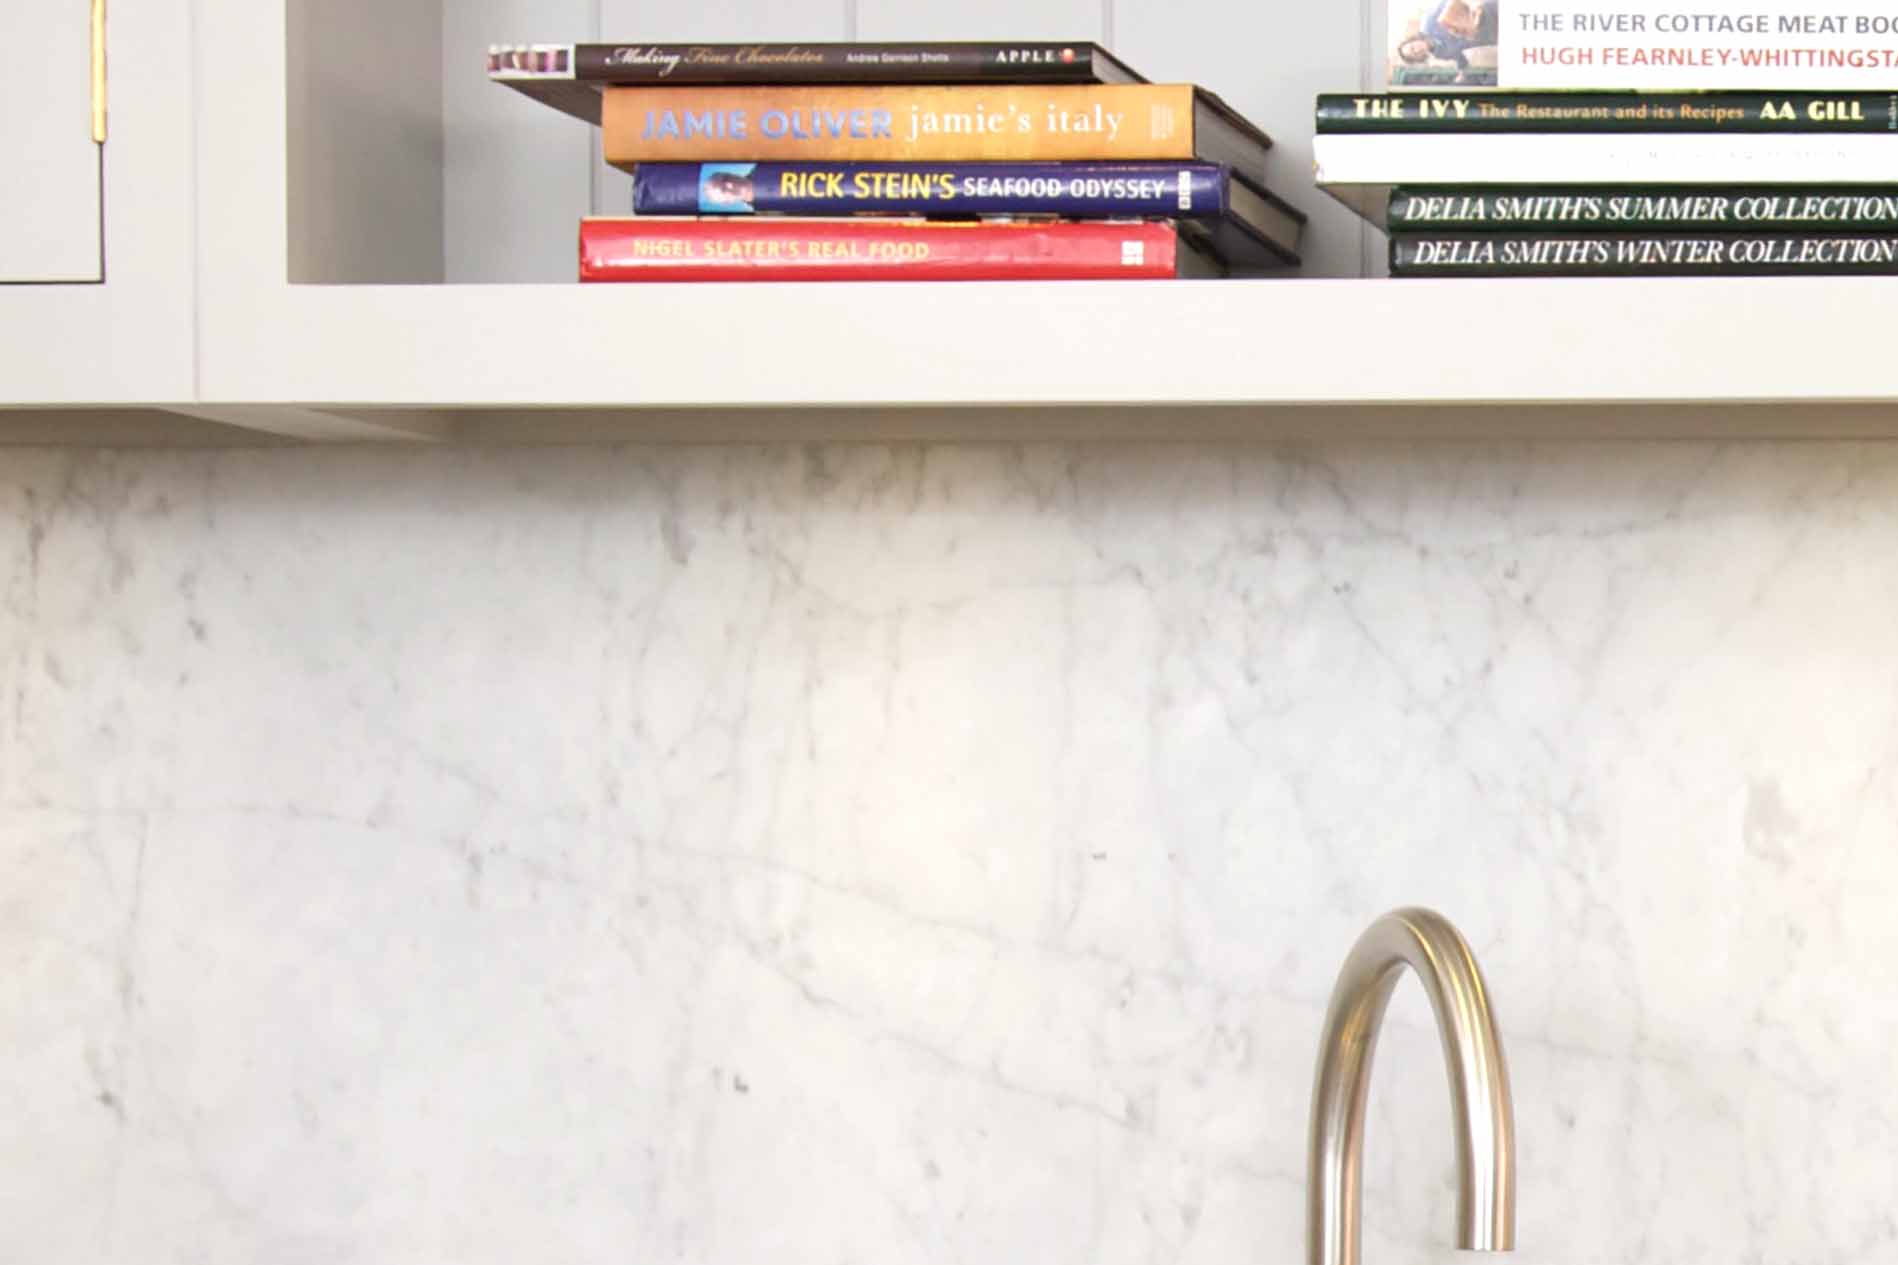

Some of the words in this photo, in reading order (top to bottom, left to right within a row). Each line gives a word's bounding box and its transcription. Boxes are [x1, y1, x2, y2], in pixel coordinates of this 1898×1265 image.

[1519, 13, 1563, 32] THE
[1573, 14, 1646, 32] RIVER
[1655, 14, 1769, 33] COTTAGE
[1778, 15, 1848, 33] MEAT
[605, 48, 680, 77] Making
[684, 48, 730, 65] Fine
[735, 46, 824, 64] Chocolates
[996, 50, 1055, 63] APPLE
[1522, 47, 1592, 65] HUGH
[1353, 99, 1403, 118] THE
[1418, 99, 1470, 118] IVY
[1479, 104, 1508, 118] The
[1517, 104, 1609, 119] Restaurant
[1615, 105, 1647, 119] and
[1652, 104, 1675, 119] its
[1680, 104, 1744, 123] Recipes
[1760, 101, 1796, 120] AA
[1807, 101, 1864, 120] GILL
[641, 110, 748, 140] JAMIE
[760, 109, 892, 139] OLIVER
[904, 104, 1032, 143] jamie's
[1048, 104, 1124, 140] italy
[780, 172, 844, 198] RICK
[853, 174, 955, 200] STEIN'S
[963, 178, 1062, 197] SEAFOOD
[1070, 178, 1166, 199] ODYSSEY
[1404, 197, 1485, 220] DELIA
[1491, 197, 1602, 220] SMITH'S
[1605, 197, 1727, 220] SUMMER
[634, 240, 692, 257] NIGEL
[704, 240, 799, 257] SLATER'S
[807, 241, 858, 258] REAL
[868, 242, 929, 258] FOOD
[1413, 241, 1496, 264] DELIA
[1501, 241, 1610, 264] SMITH'S
[1616, 240, 1723, 264] WINTER
[1728, 239, 1898, 264] COLLECTION
